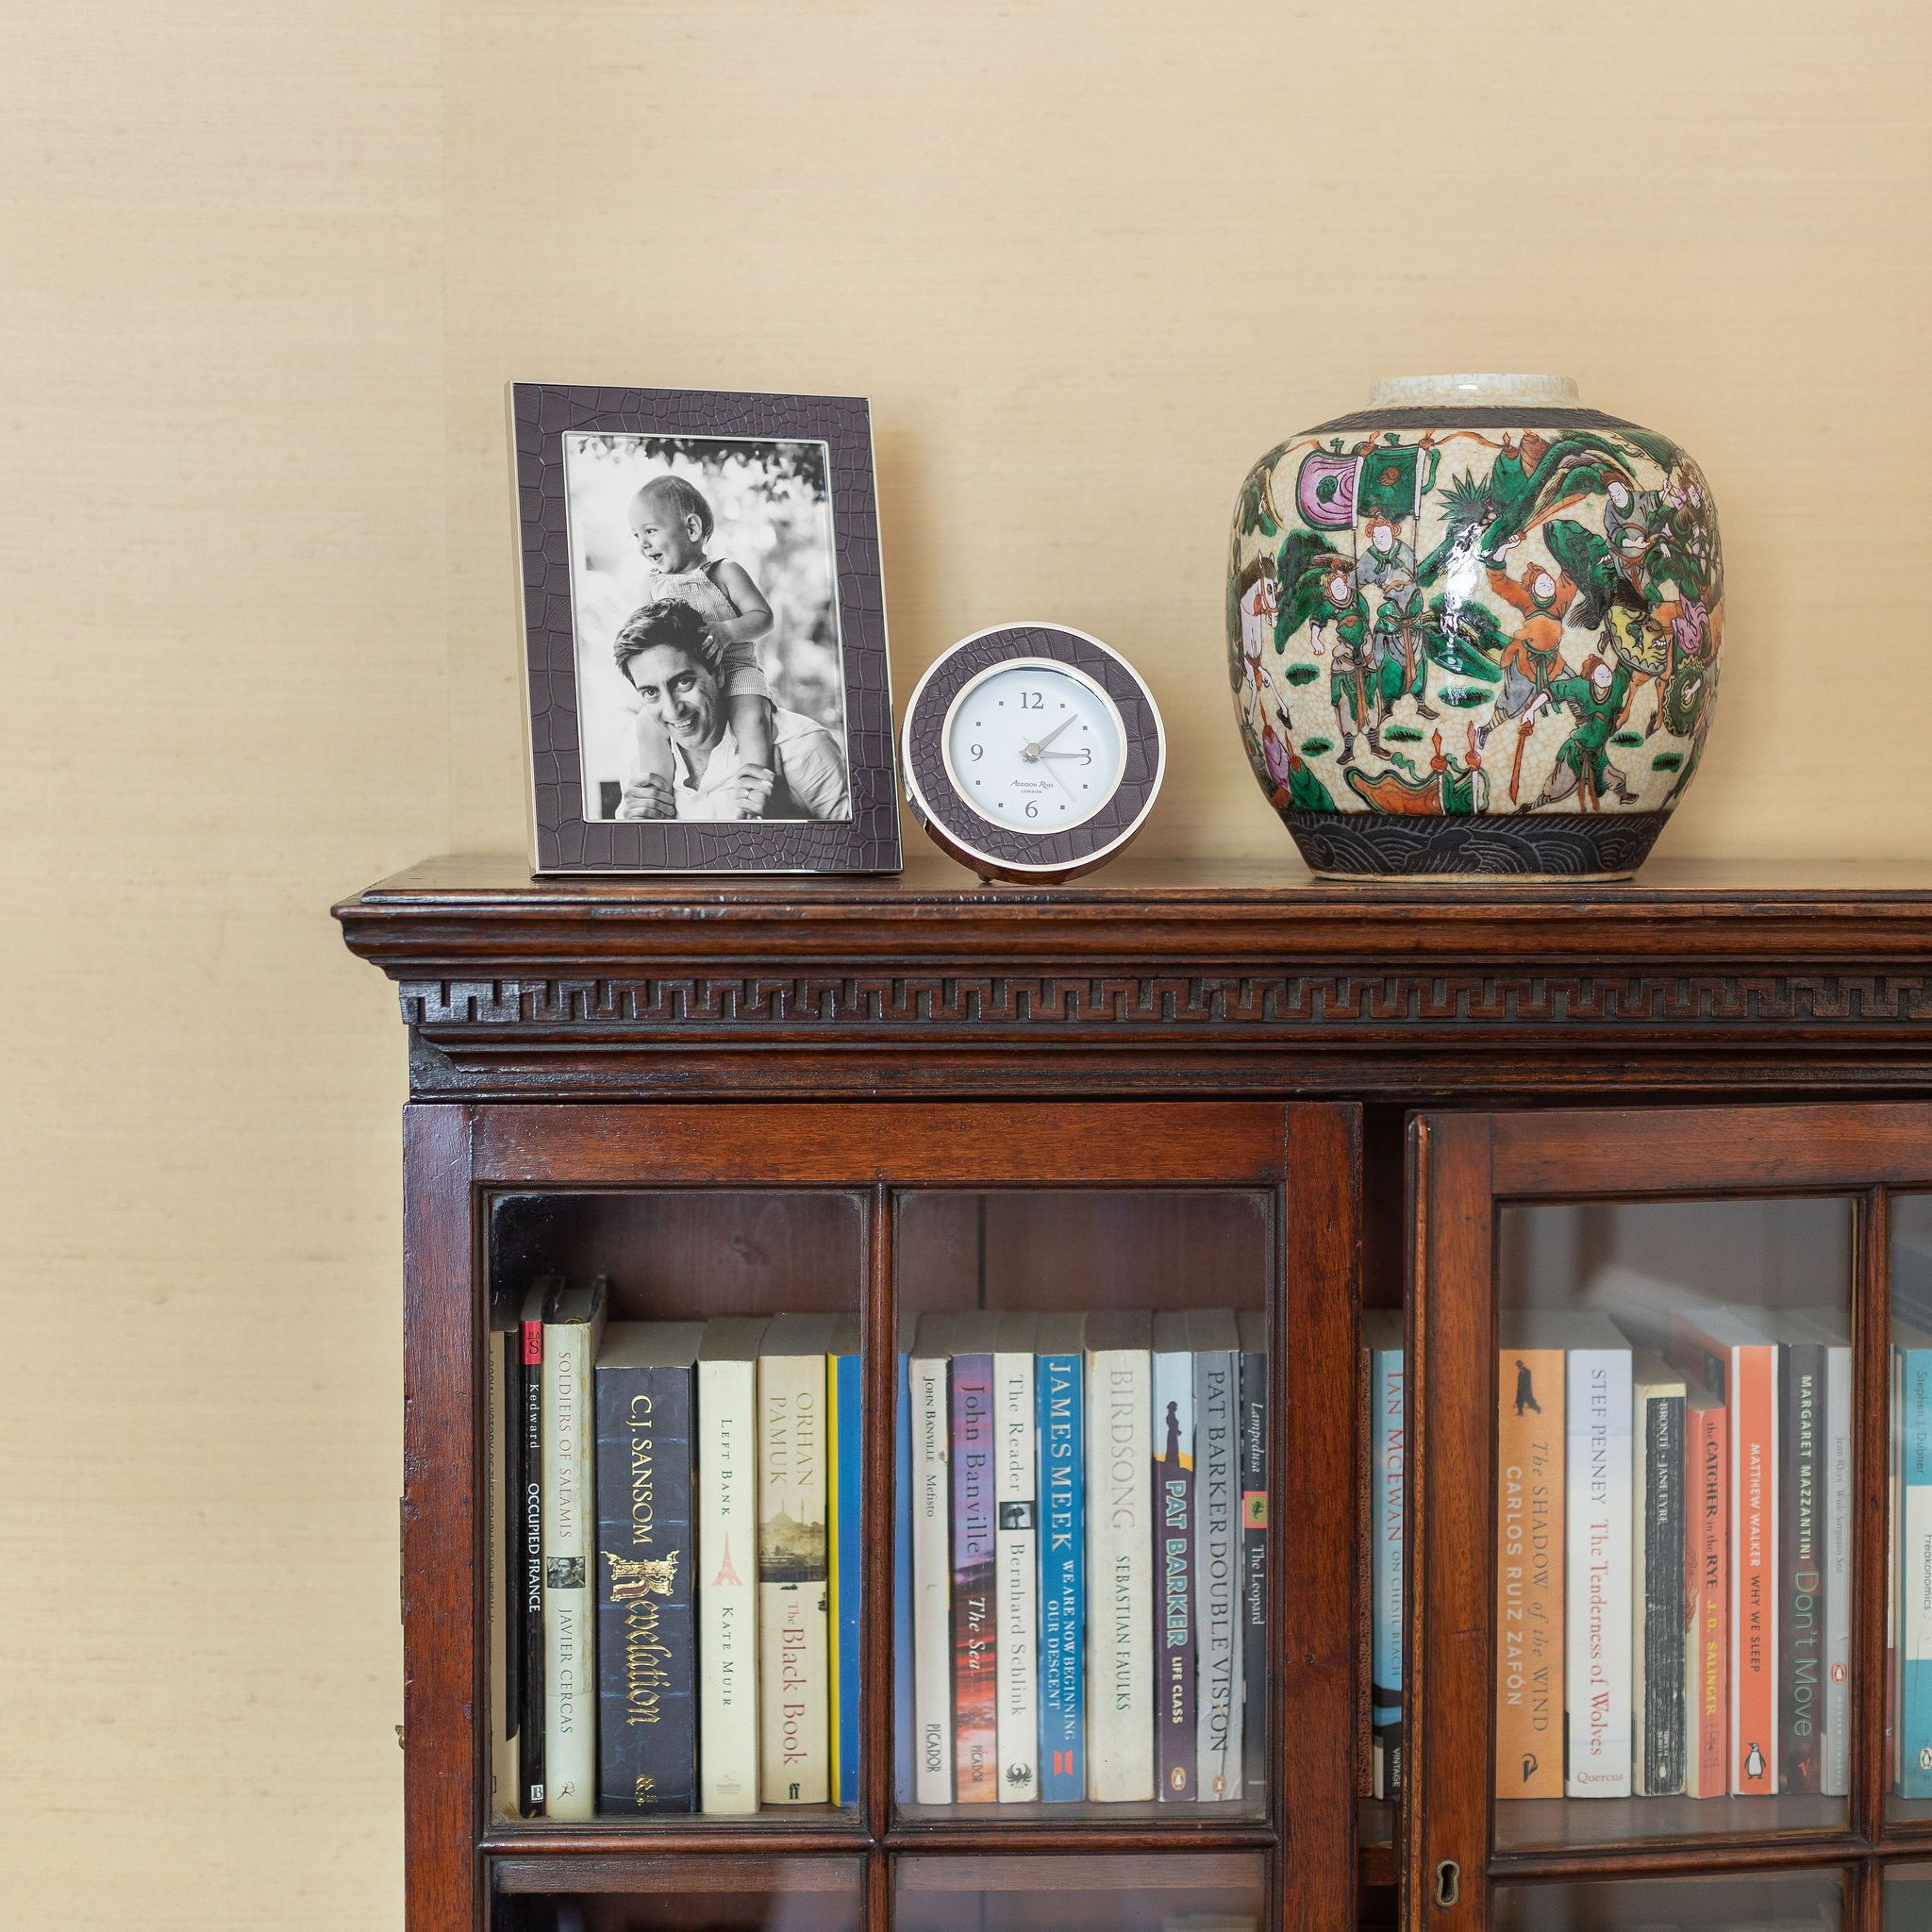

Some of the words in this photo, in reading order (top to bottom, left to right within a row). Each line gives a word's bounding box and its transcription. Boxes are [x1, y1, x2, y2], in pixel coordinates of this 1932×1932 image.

[1020, 691, 1044, 709] 12
[970, 743, 984, 761] 9
[1079, 748, 1092, 765] 3
[1024, 801, 1038, 818] 6
[528, 1383, 541, 1449] Kedward
[558, 1351, 572, 1432] SOLDIERS
[625, 1394, 653, 1433] C.J.
[923, 1376, 936, 1407] JOHN
[961, 1384, 986, 1441] John
[1008, 1374, 1024, 1413] The
[1050, 1362, 1072, 1458] JAMES
[1208, 1370, 1226, 1420] PAT
[1387, 1372, 1404, 1415] IAN
[1591, 1368, 1607, 1417] STEF
[1800, 1374, 1812, 1457] MARGARET
[1914, 1371, 1927, 1417] Stephen
[721, 1419, 732, 1461] LEFT
[769, 1396, 787, 1486] PAMUK
[795, 1392, 814, 1487] ORHAN
[925, 1410, 937, 1463] BANVILLE
[1248, 1402, 1264, 1474] Lampedusa
[1706, 1422, 1718, 1440] the
[1915, 1420, 1926, 1428] J.
[558, 1439, 572, 1460] OF
[1008, 1422, 1024, 1492] Reader
[1110, 1370, 1136, 1530] BIRDSONG
[1532, 1441, 1549, 1477] The
[1591, 1424, 1607, 1506] PENNEY
[1915, 1432, 1927, 1474] Dubner
[631, 1438, 654, 1545] SANSOM
[721, 1470, 732, 1517] BANK
[925, 1474, 937, 1518] Mefisto
[1208, 1425, 1227, 1536] BARKER
[1706, 1441, 1719, 1518] CATCHER
[1749, 1441, 1761, 1509] MATTHEW
[1835, 1488, 1845, 1512] Wide
[527, 1482, 541, 1555] OCCUPIED
[558, 1468, 572, 1539] SALAMIS
[965, 1452, 988, 1555] Banville
[1050, 1465, 1073, 1553] MEEK
[1165, 1479, 1189, 1530] PAT
[1506, 1465, 1523, 1557] CARLOS
[1658, 1492, 1669, 1524] EYRE
[1706, 1521, 1717, 1532] in
[1799, 1464, 1812, 1559] MAZZANTINI
[1252, 1544, 1265, 1570] The
[1532, 1486, 1549, 1591] SHADOW
[1590, 1519, 1609, 1557] The
[1706, 1535, 1718, 1553] the
[1749, 1513, 1761, 1567] WALKER
[1834, 1515, 1845, 1556] Sargasso
[528, 1558, 541, 1613] FRANCE
[1062, 1559, 1074, 1583] WE
[1391, 1550, 1401, 1574] ON
[1706, 1554, 1719, 1591] RYE
[1835, 1557, 1845, 1574] Sea
[787, 1602, 800, 1624] The
[1009, 1542, 1026, 1635] Bernhard
[1063, 1586, 1075, 1616] ARE
[1116, 1556, 1131, 1644] SEBASTIAN
[1165, 1538, 1190, 1649] BARKER
[1210, 1541, 1229, 1651] DOUBLE
[1248, 1573, 1265, 1624] Leopard
[1506, 1566, 1523, 1623] RUIZ
[1527, 1601, 1550, 1624] of
[1590, 1560, 1609, 1659] Tenderness
[1707, 1600, 1718, 1613] J.
[1750, 1574, 1761, 1607] WHY
[1794, 1571, 1819, 1646] Don't
[557, 1607, 573, 1663] JAVIER
[600, 1549, 680, 1726] Revelation
[722, 1607, 734, 1651] KATE
[968, 1596, 986, 1632] The
[1047, 1600, 1059, 1632] OUR
[1063, 1620, 1075, 1652] NOW
[1707, 1617, 1718, 1634] D.
[1750, 1611, 1760, 1632] WE
[782, 1627, 808, 1692] Black
[968, 1638, 986, 1671] Sea
[1391, 1632, 1402, 1677] BEACH
[1532, 1628, 1550, 1657] the
[1750, 1636, 1760, 1673] SLEEP
[722, 1660, 734, 1707] MUIR
[1009, 1643, 1027, 1716] Schlink
[1047, 1637, 1060, 1710] DESCENT
[1116, 1651, 1131, 1711] FAULKS
[1171, 1656, 1183, 1681] LIFE
[1506, 1630, 1525, 1706] ZAFÓN
[1590, 1664, 1609, 1686] of
[1706, 1641, 1719, 1716] SALINGER
[559, 1669, 573, 1734] CERCAS
[1063, 1656, 1075, 1741] BEGINNING
[1171, 1684, 1184, 1724] CLASS
[1210, 1656, 1229, 1752] VISION
[1532, 1666, 1549, 1732] WIND
[1794, 1658, 1819, 1738] Move
[782, 1703, 808, 1767] Book
[926, 1723, 941, 1774] PICADOR
[1590, 1690, 1609, 1757] Wolves
[972, 1744, 984, 1783] PICADOR
[1391, 1747, 1402, 1788] VINTAGE
[1577, 1772, 1624, 1784] Quercus
